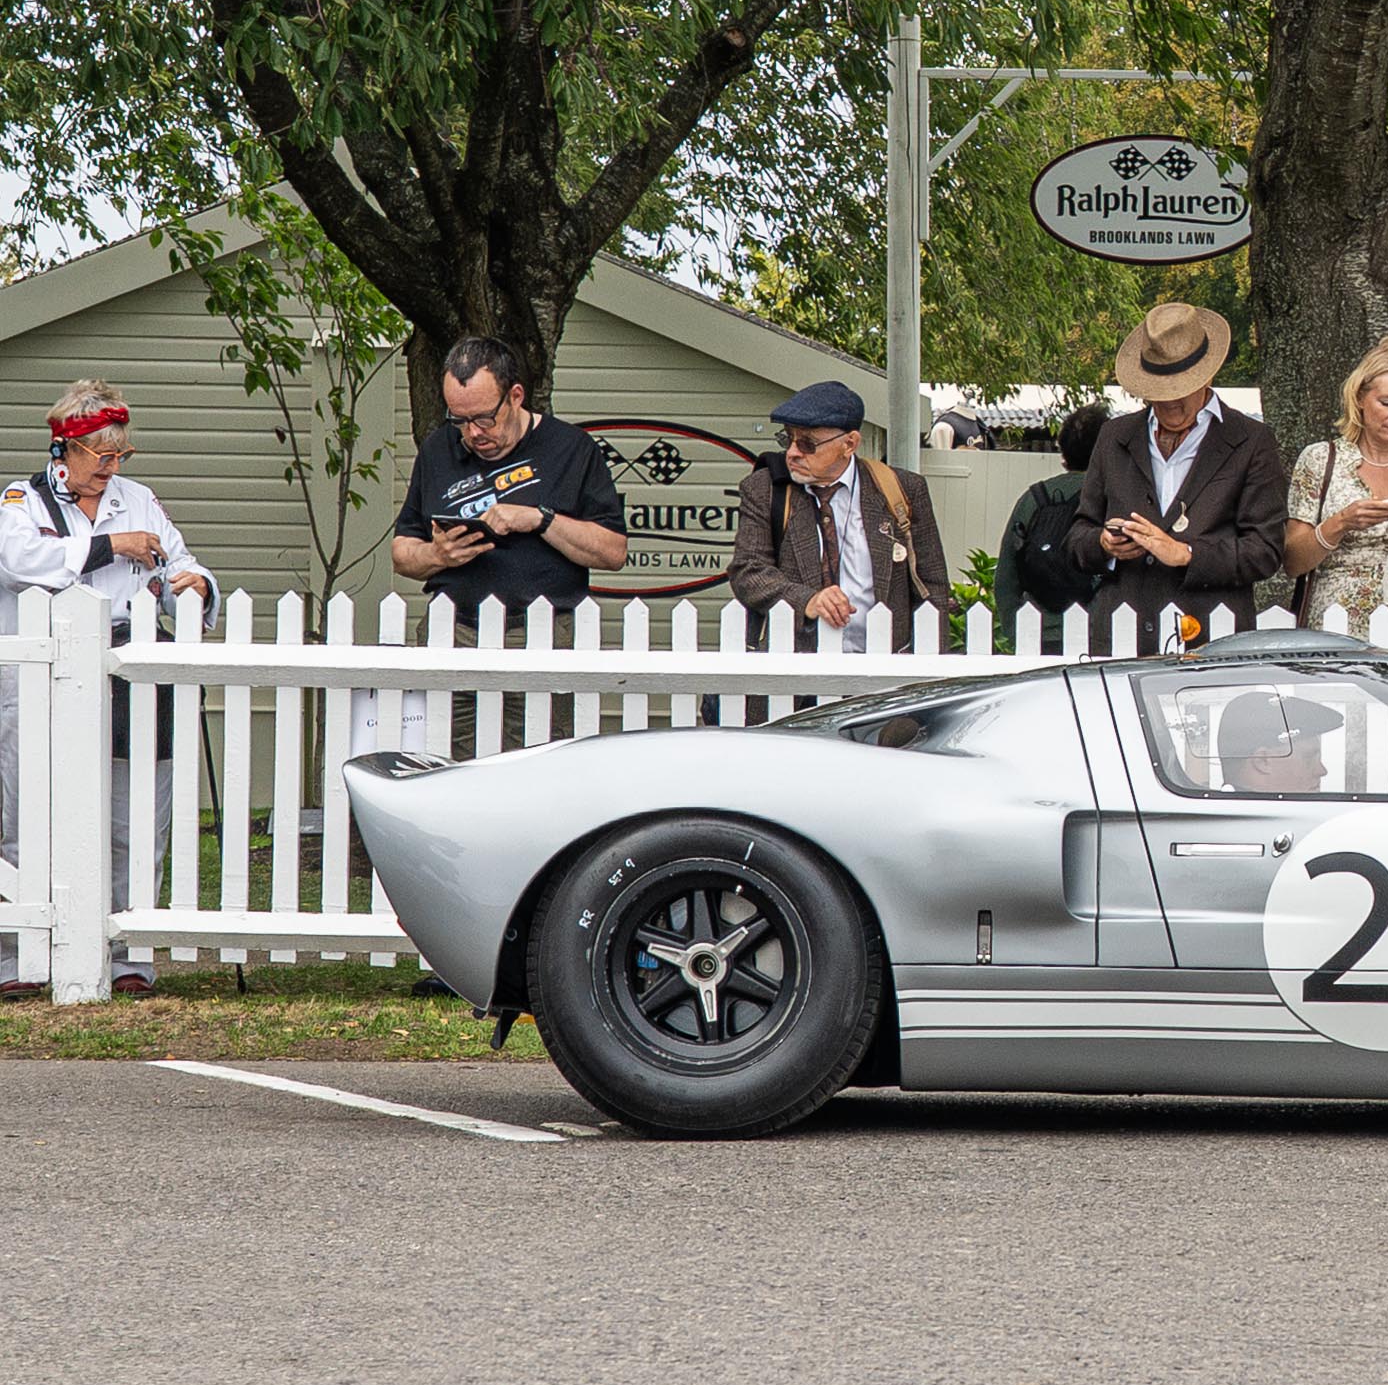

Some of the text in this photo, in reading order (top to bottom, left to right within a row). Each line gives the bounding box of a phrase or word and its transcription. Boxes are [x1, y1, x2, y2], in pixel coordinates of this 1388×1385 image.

[1056, 184, 1242, 224] Ralph Lauren
[1089, 230, 1215, 245] BROOKLANDS LAWN
[669, 553, 721, 568] LAWN
[608, 868, 624, 886] SET
[578, 909, 595, 929] RR
